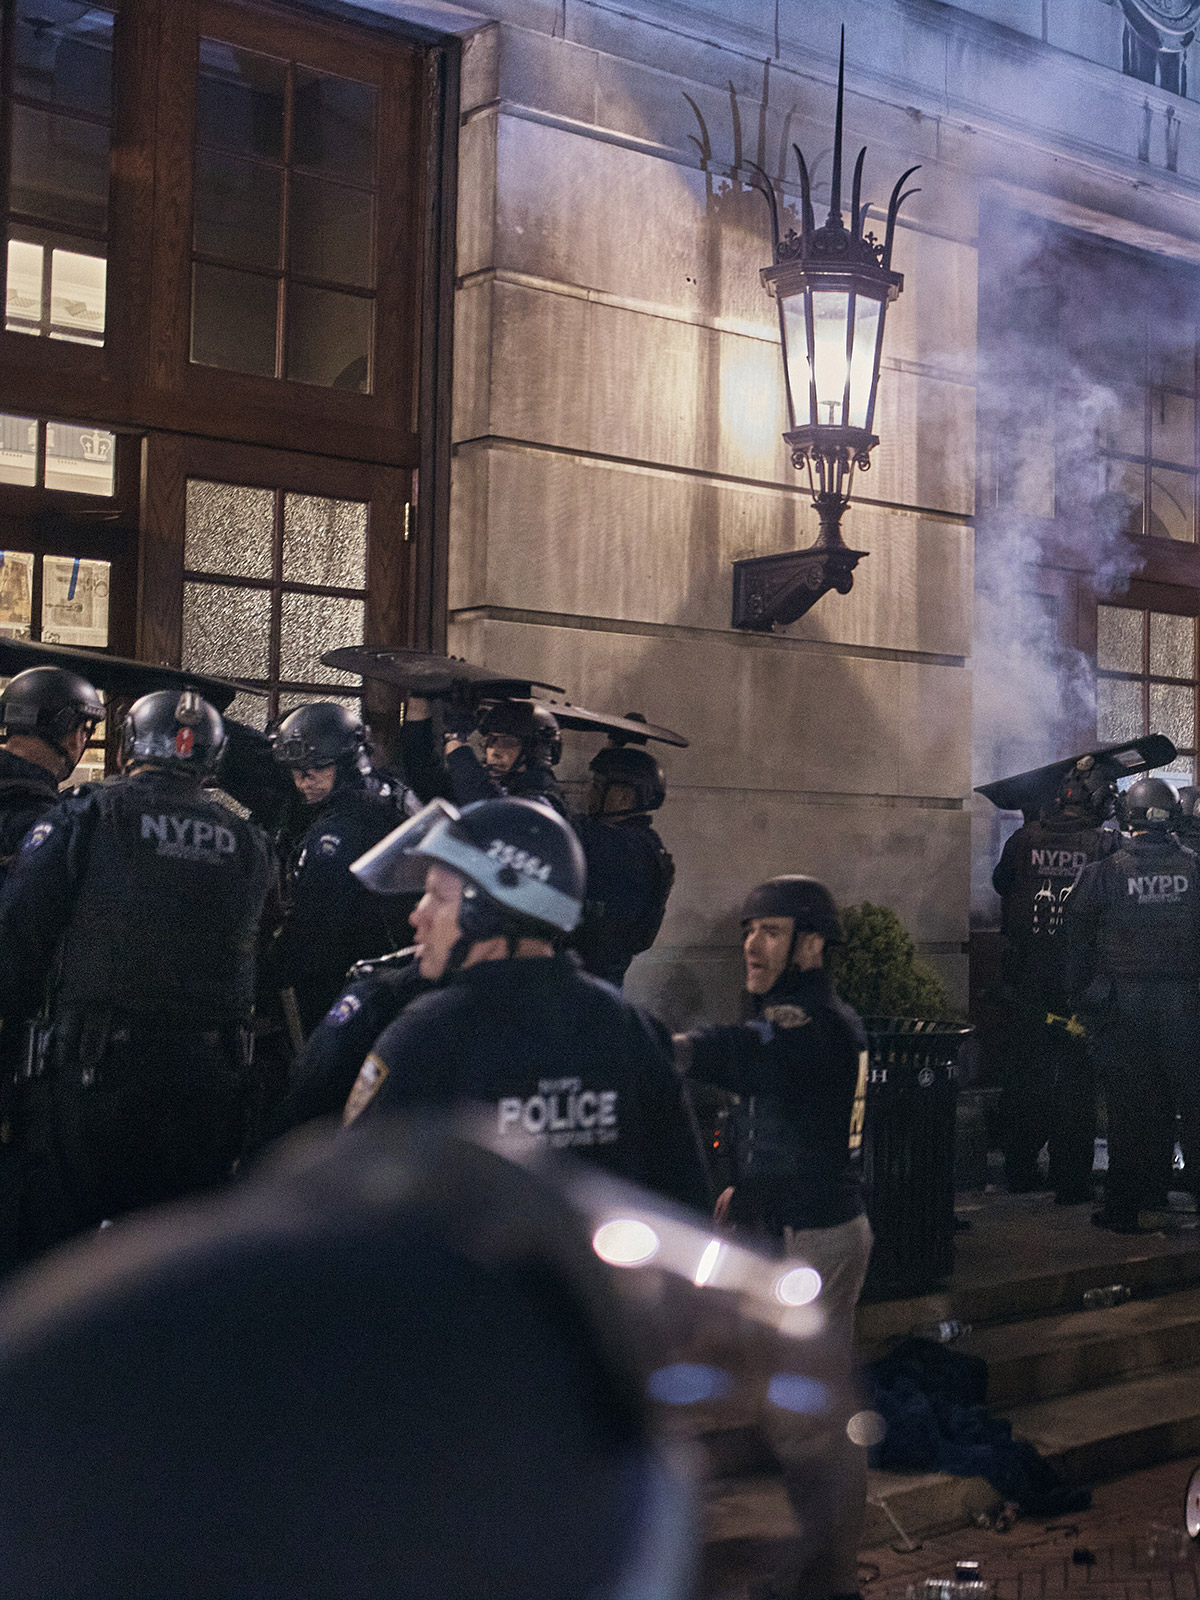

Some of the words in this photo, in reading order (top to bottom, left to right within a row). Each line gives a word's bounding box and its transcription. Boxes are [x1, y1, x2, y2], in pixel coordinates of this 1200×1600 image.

[141, 814, 237, 853] NYPD
[1032, 849, 1087, 868] NYPD
[1127, 875, 1189, 895] NYPD
[498, 1090, 618, 1134] POLICE
